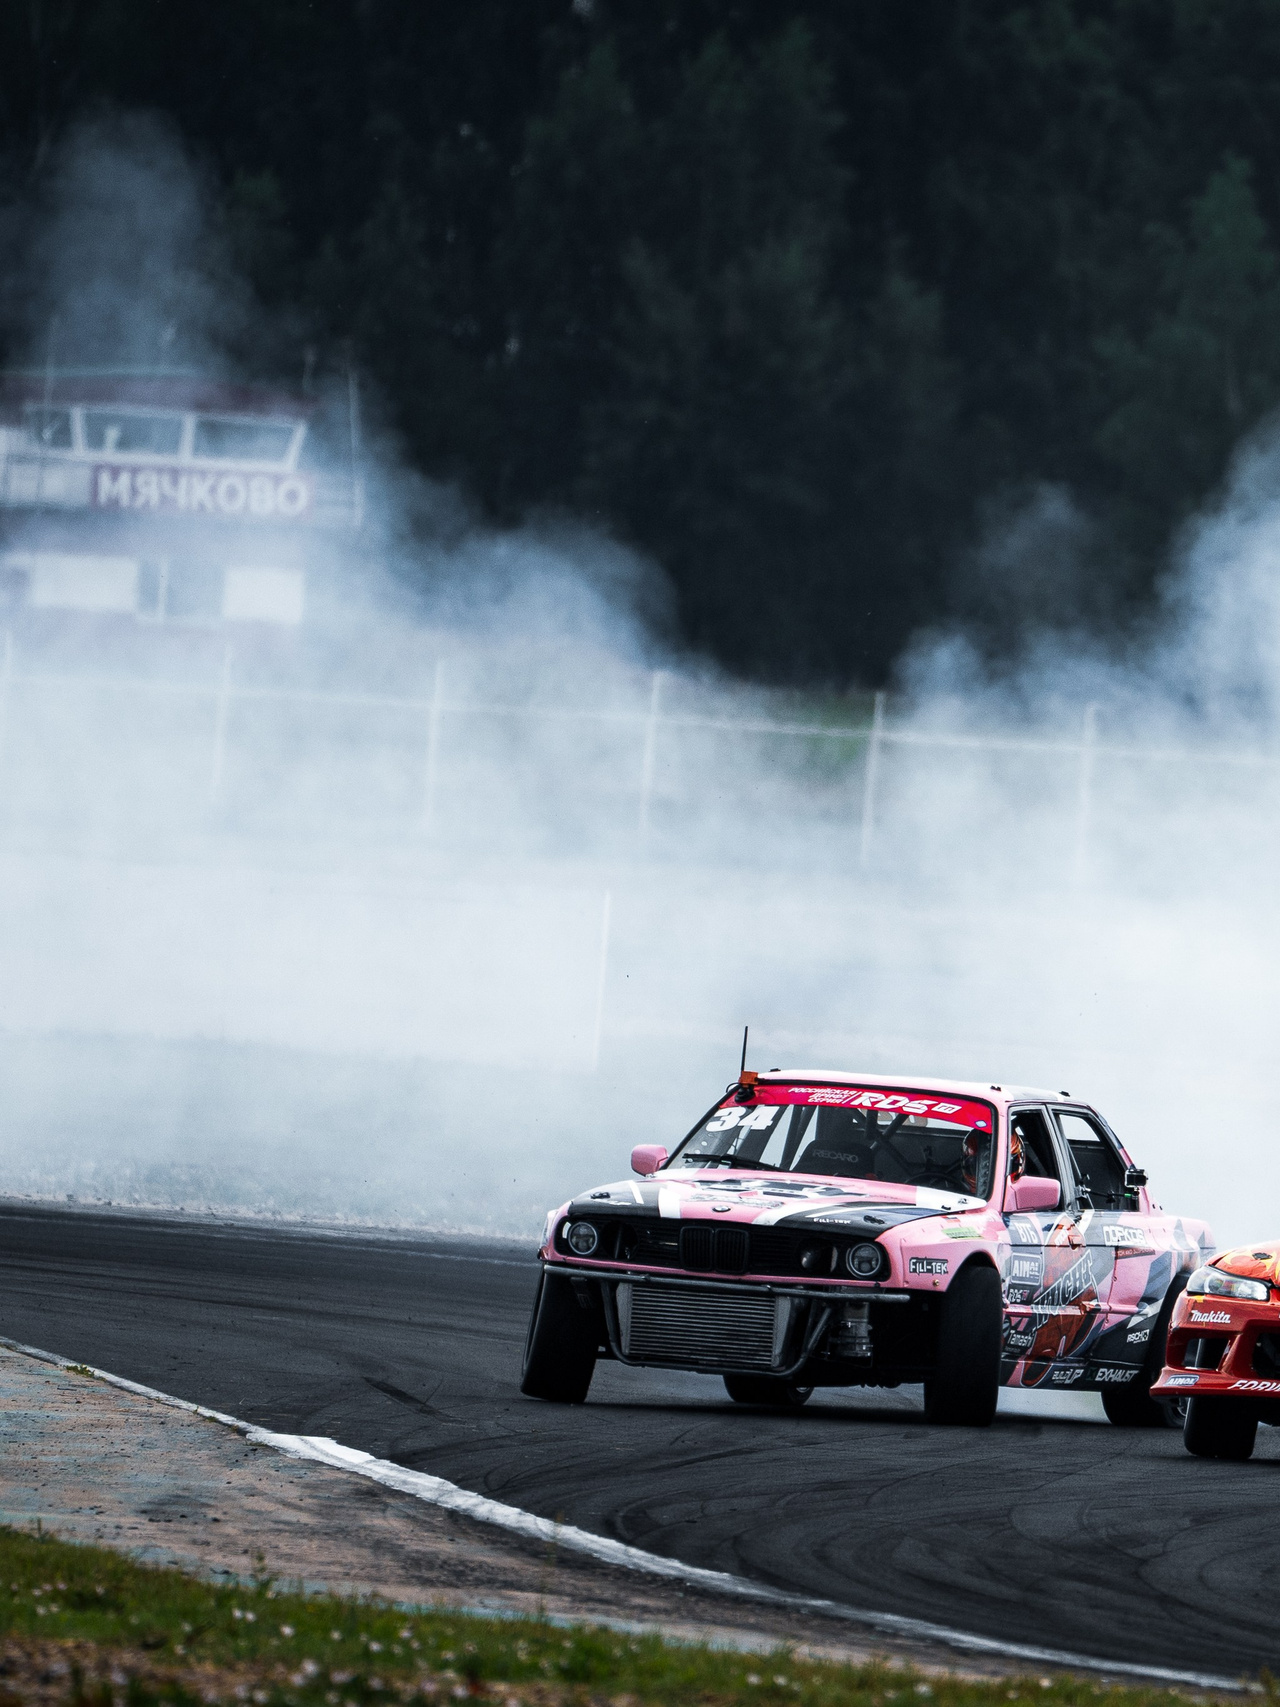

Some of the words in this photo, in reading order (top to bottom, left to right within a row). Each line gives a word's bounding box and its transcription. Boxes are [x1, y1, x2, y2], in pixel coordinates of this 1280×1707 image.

[97, 470, 310, 516] МЯЧКОВО
[850, 1091, 938, 1114] RDS
[705, 1105, 780, 1132] 34
[812, 1149, 860, 1163] RECARO
[1014, 1222, 1039, 1244] ВТБ
[1012, 1259, 1040, 1278] AIMOL
[1007, 1329, 1036, 1348] Tamashi
[1095, 1367, 1139, 1382] EXHAUST
